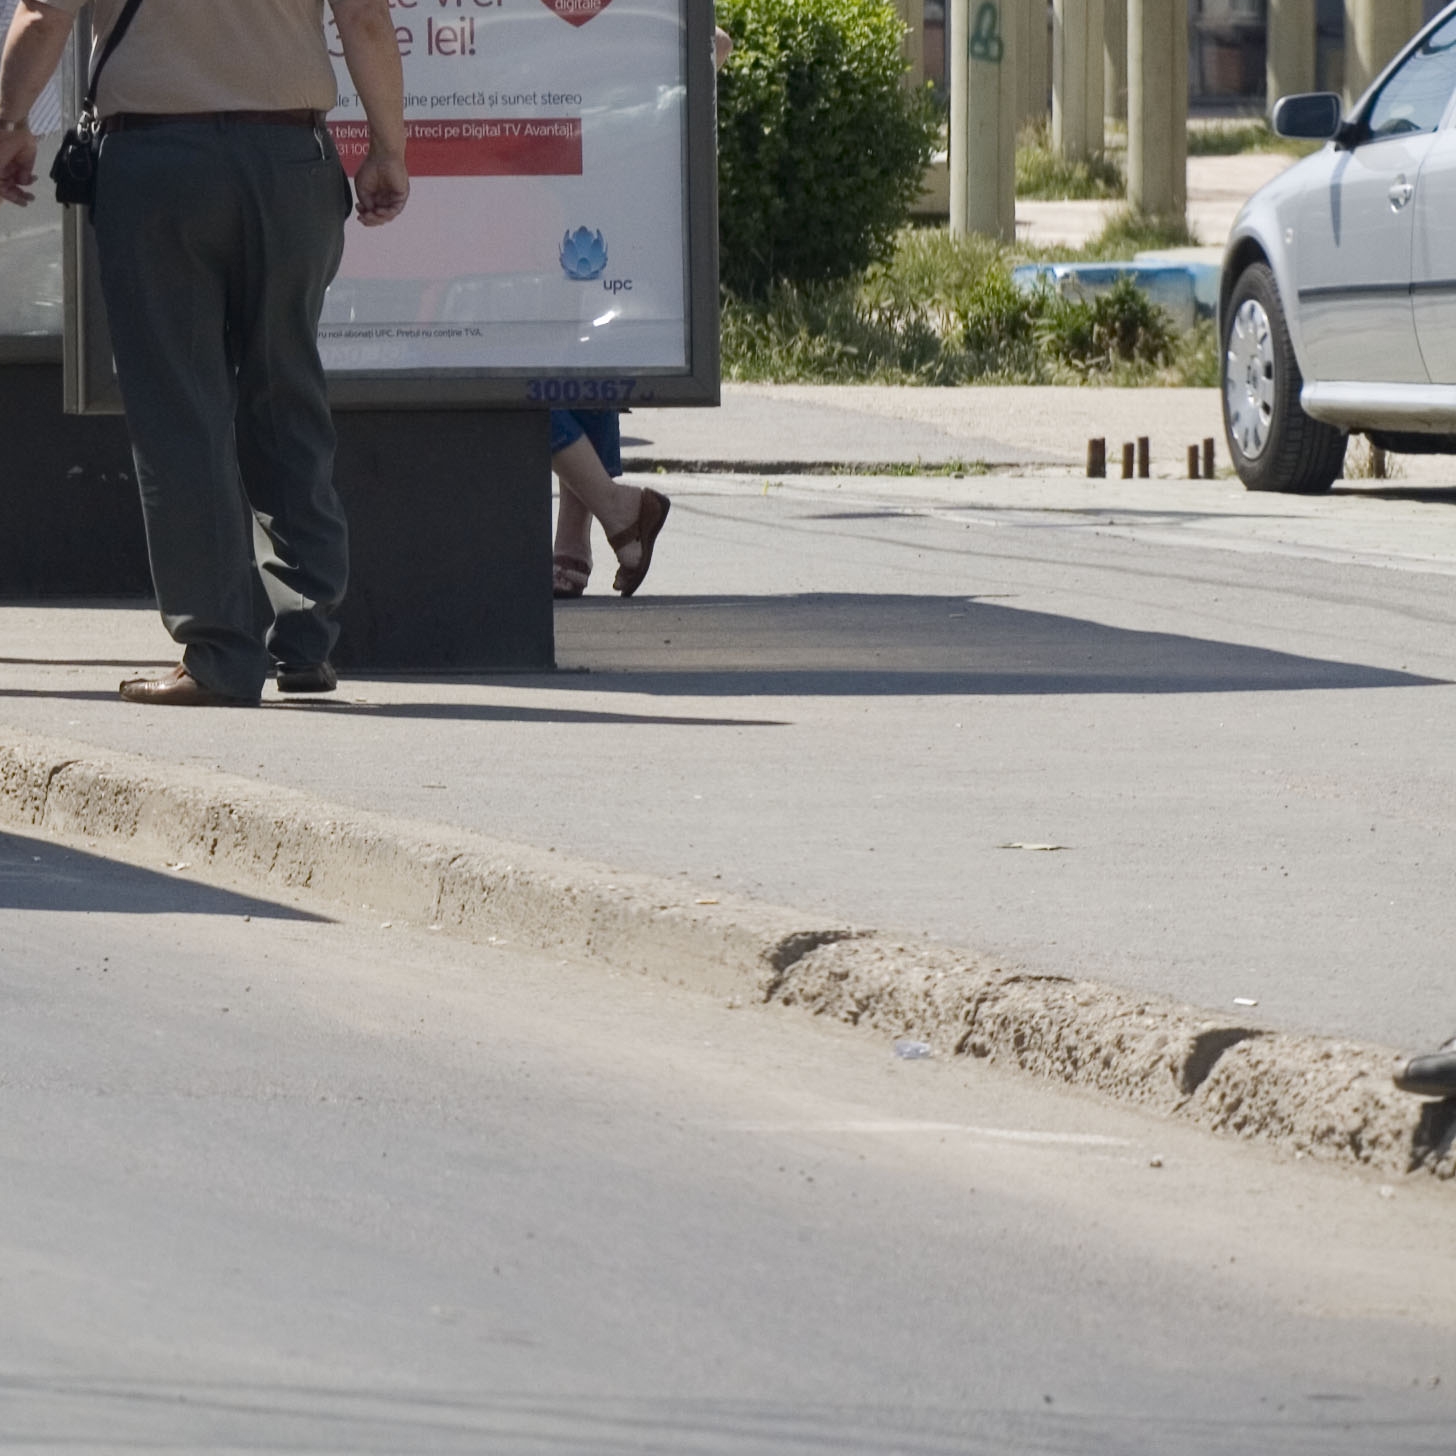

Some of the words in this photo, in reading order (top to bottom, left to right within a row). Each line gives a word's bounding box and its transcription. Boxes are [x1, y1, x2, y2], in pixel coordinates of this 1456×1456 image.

[427, 17, 476, 56] lei!
[431, 91, 485, 109] perfectă
[501, 91, 538, 105] sunet
[541, 91, 582, 105] stereo
[414, 125, 441, 137] treci
[444, 127, 459, 139] pe
[462, 123, 500, 139] Digital
[503, 123, 521, 136] TV
[603, 279, 633, 295] upc
